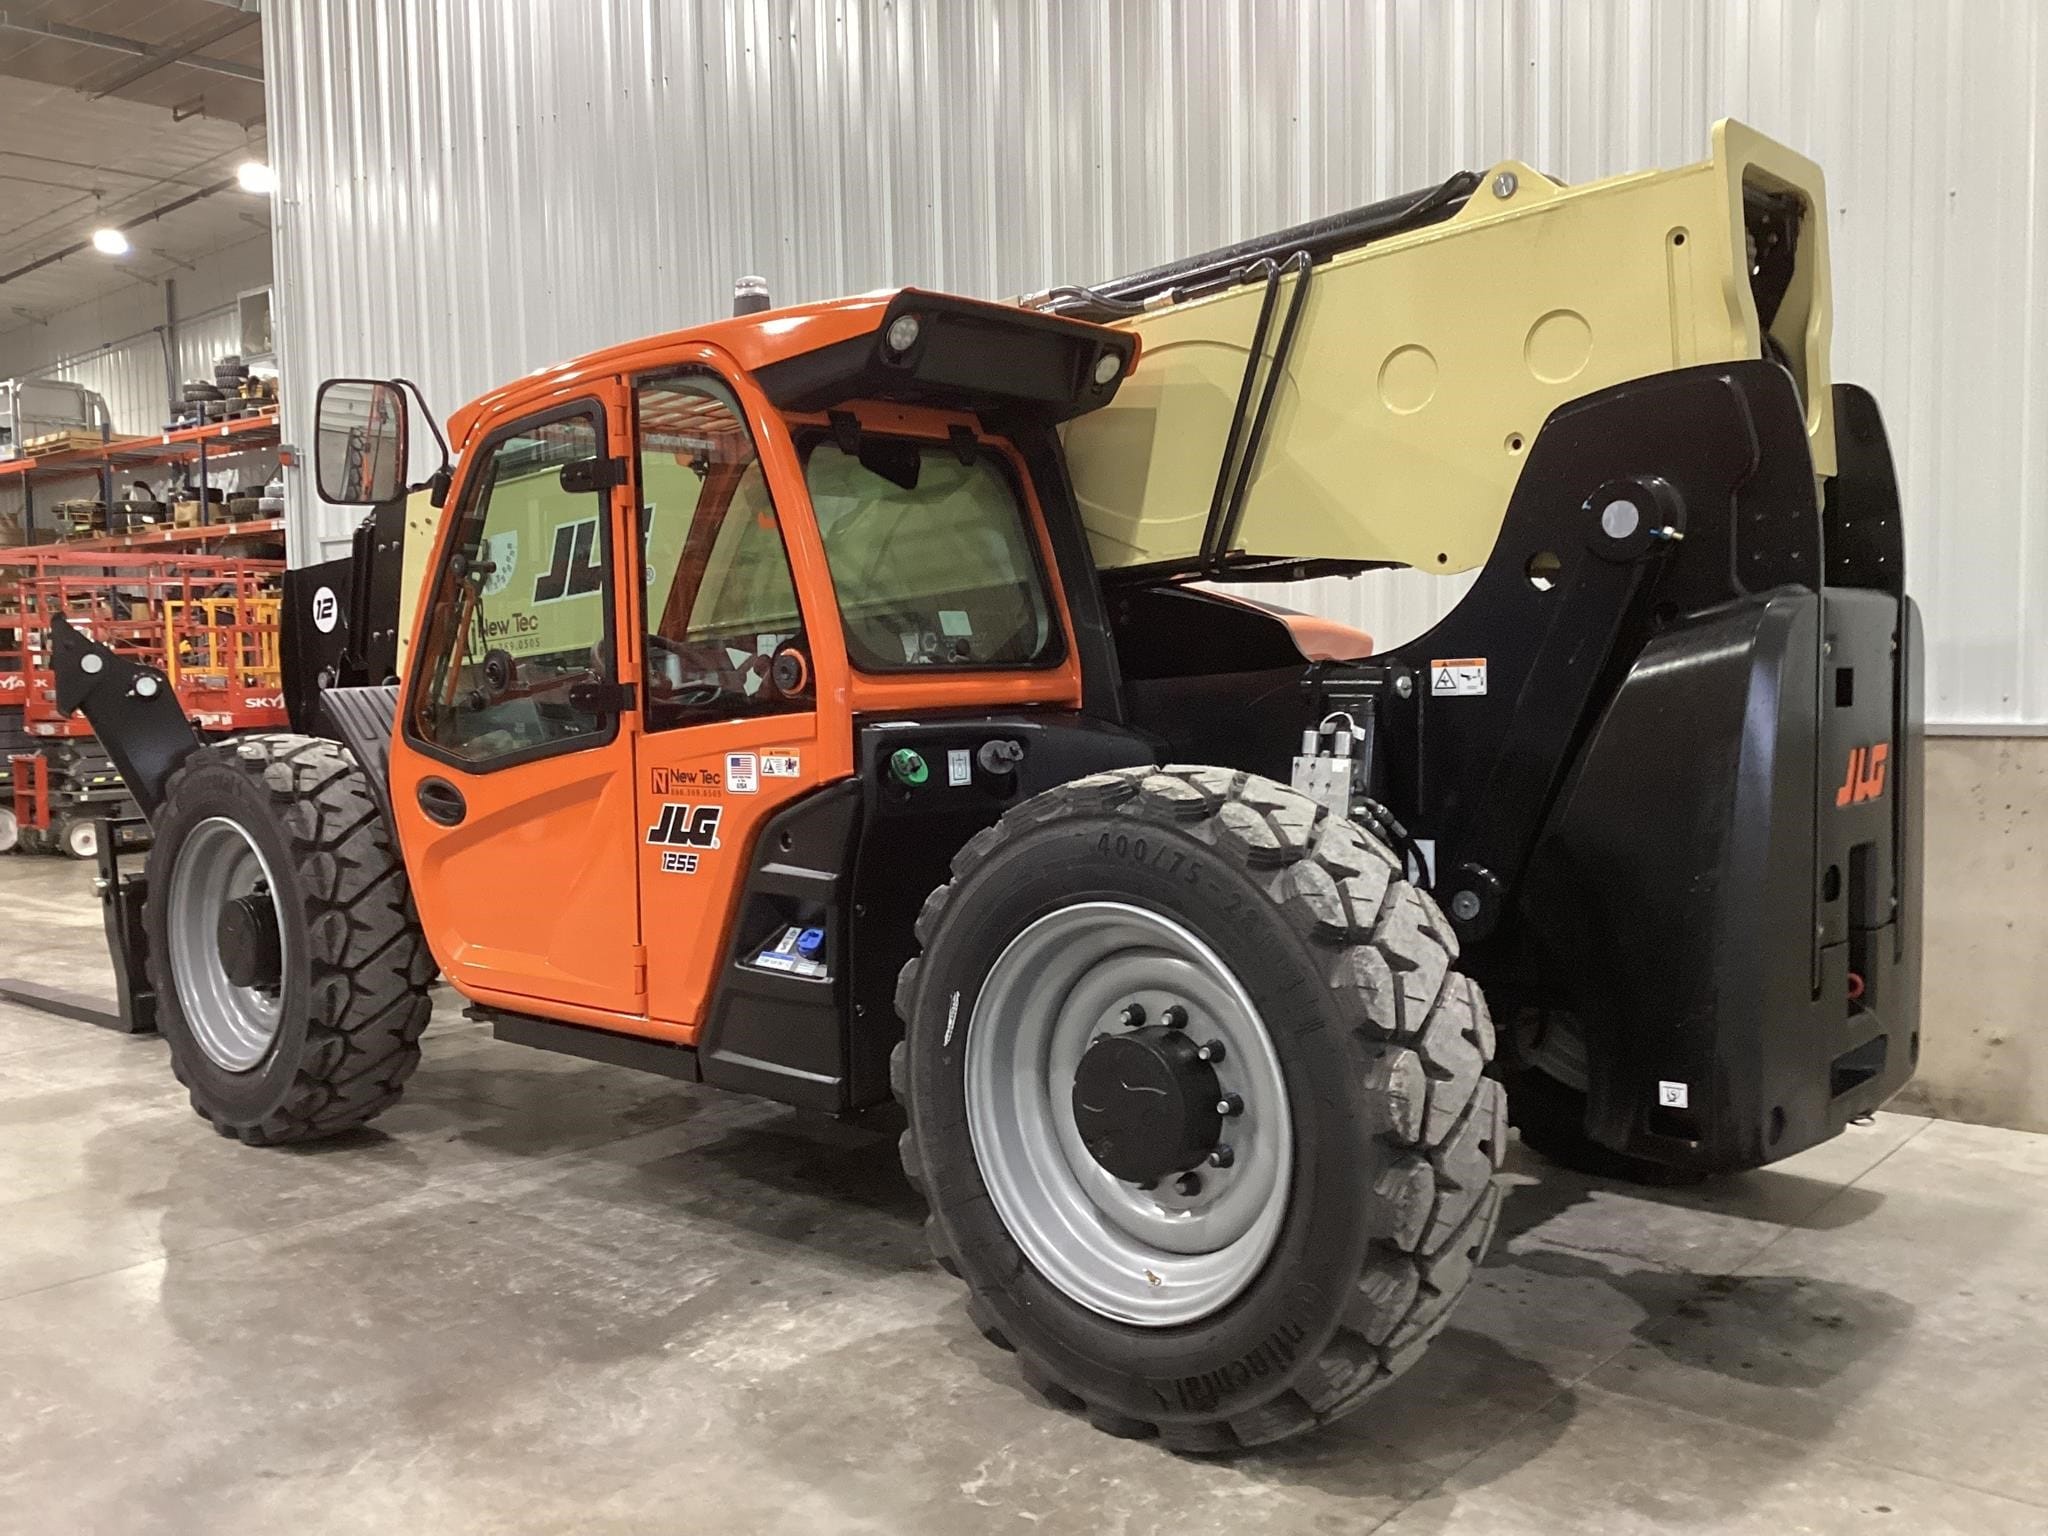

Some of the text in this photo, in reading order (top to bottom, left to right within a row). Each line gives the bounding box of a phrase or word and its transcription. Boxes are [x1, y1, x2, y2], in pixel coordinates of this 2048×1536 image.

[316, 597, 334, 620] 12
[512, 611, 539, 632] Tec
[670, 769, 697, 783] New
[700, 769, 721, 784] Tec
[1835, 743, 1889, 807] JLG
[647, 804, 722, 848] JLG
[662, 852, 698, 872] 1255
